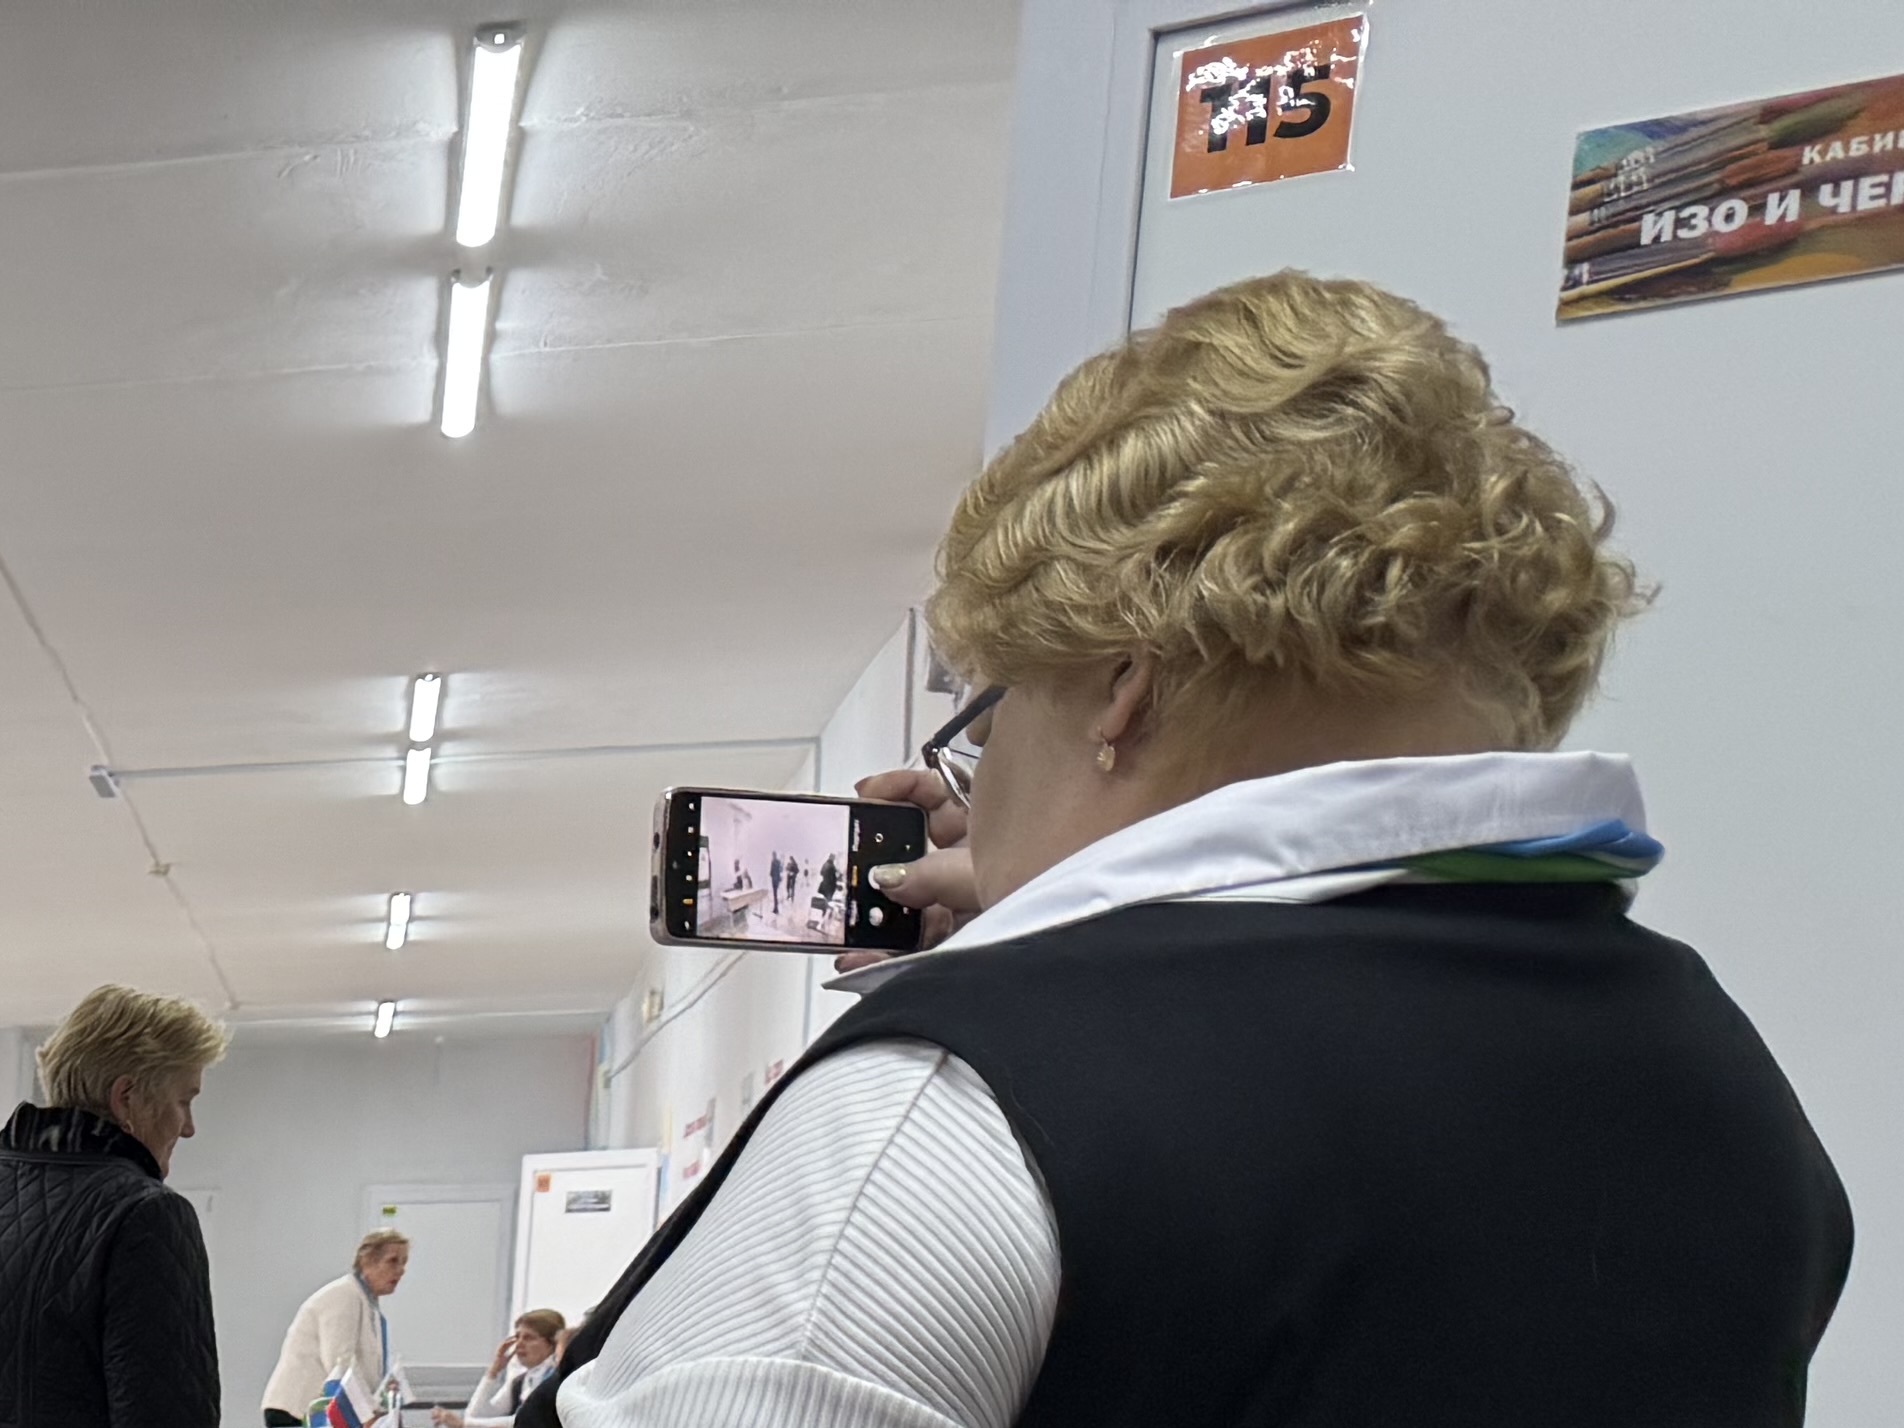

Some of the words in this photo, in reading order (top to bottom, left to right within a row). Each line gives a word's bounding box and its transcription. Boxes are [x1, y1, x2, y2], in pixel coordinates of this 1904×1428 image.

[1199, 63, 1331, 153] 115
[1640, 198, 1749, 246] ИЗО
[1764, 189, 1802, 226] И
